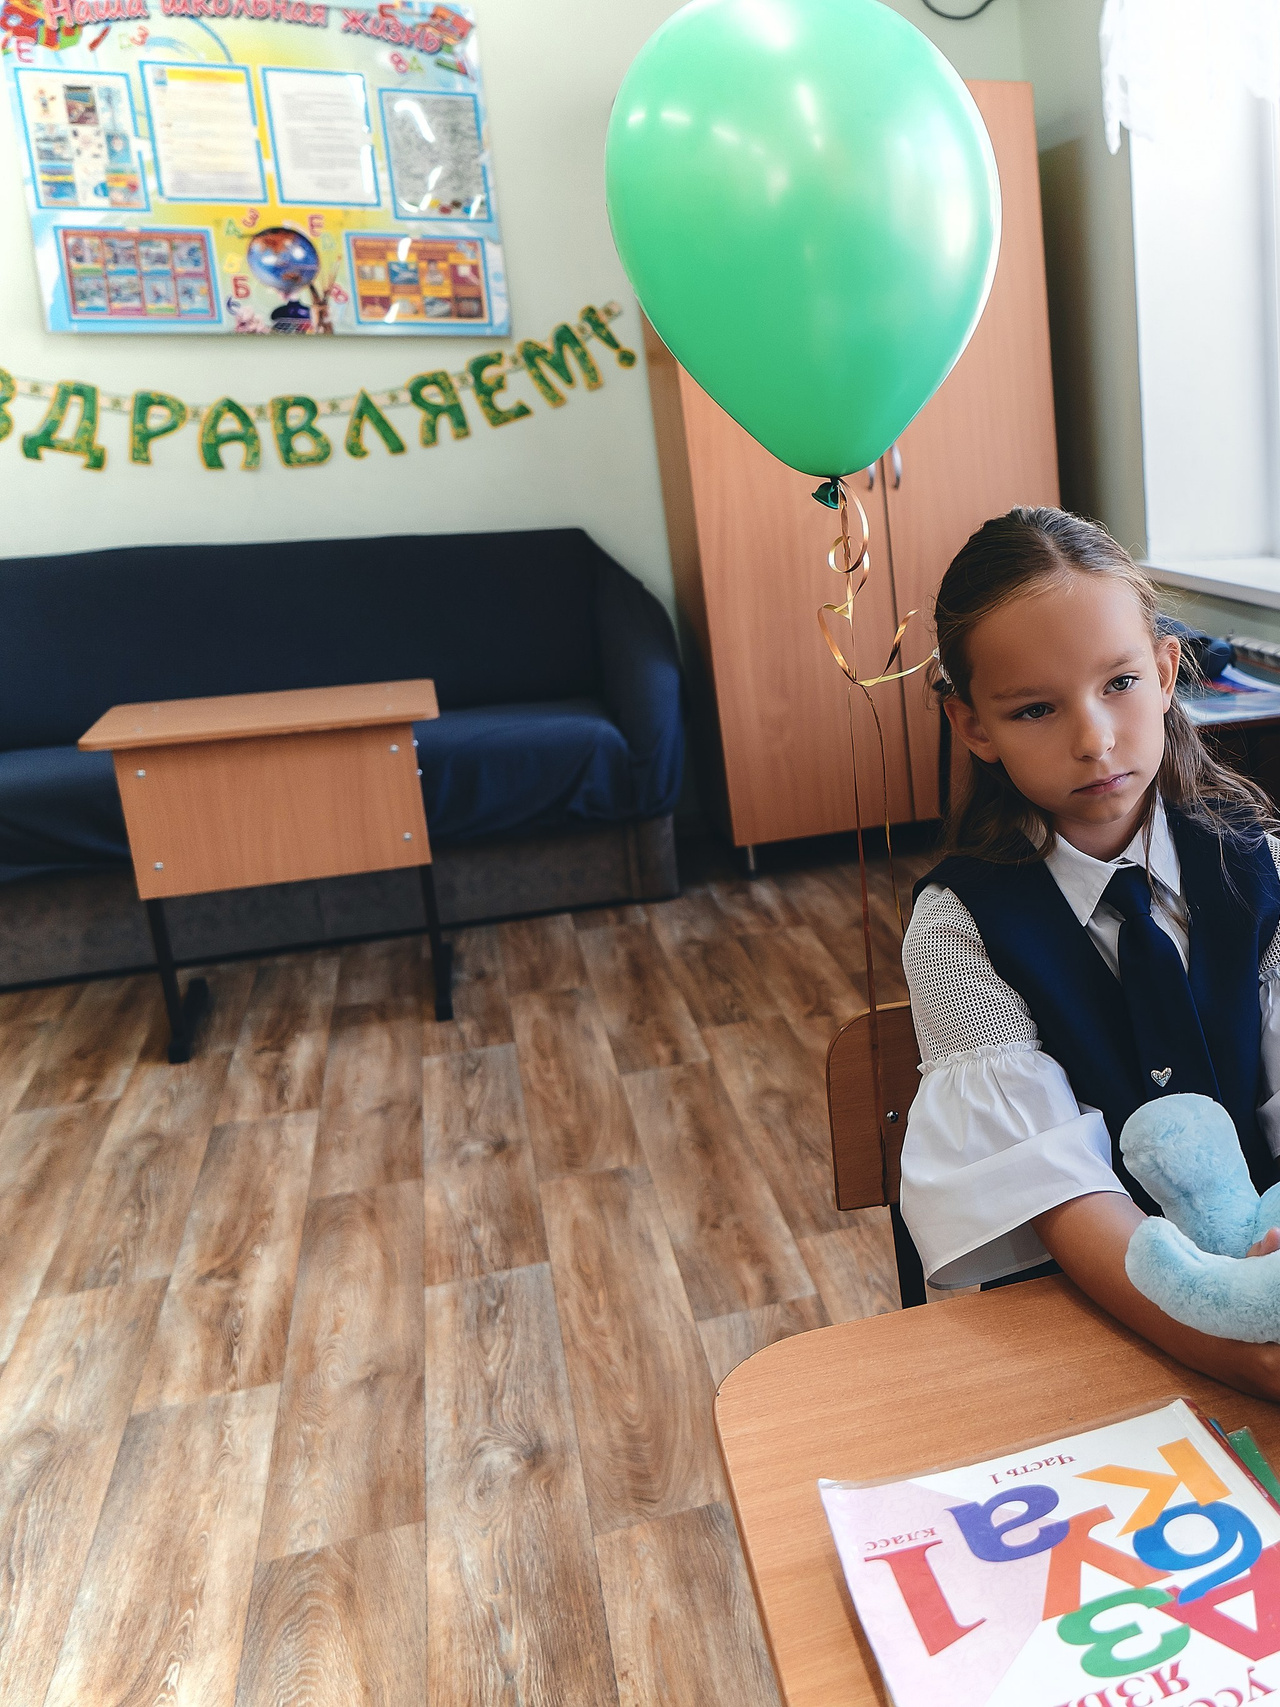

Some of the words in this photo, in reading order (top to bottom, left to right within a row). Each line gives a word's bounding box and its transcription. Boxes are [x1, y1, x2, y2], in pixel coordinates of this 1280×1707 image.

[44, 0, 149, 31] Наша
[161, 0, 328, 27] школьная
[341, 8, 442, 54] жизнь
[232, 275, 251, 299] Б
[1006, 1453, 1076, 1478] Часть
[989, 1472, 1003, 1485] 1
[865, 1527, 937, 1551] класс
[864, 1538, 988, 1657] 1
